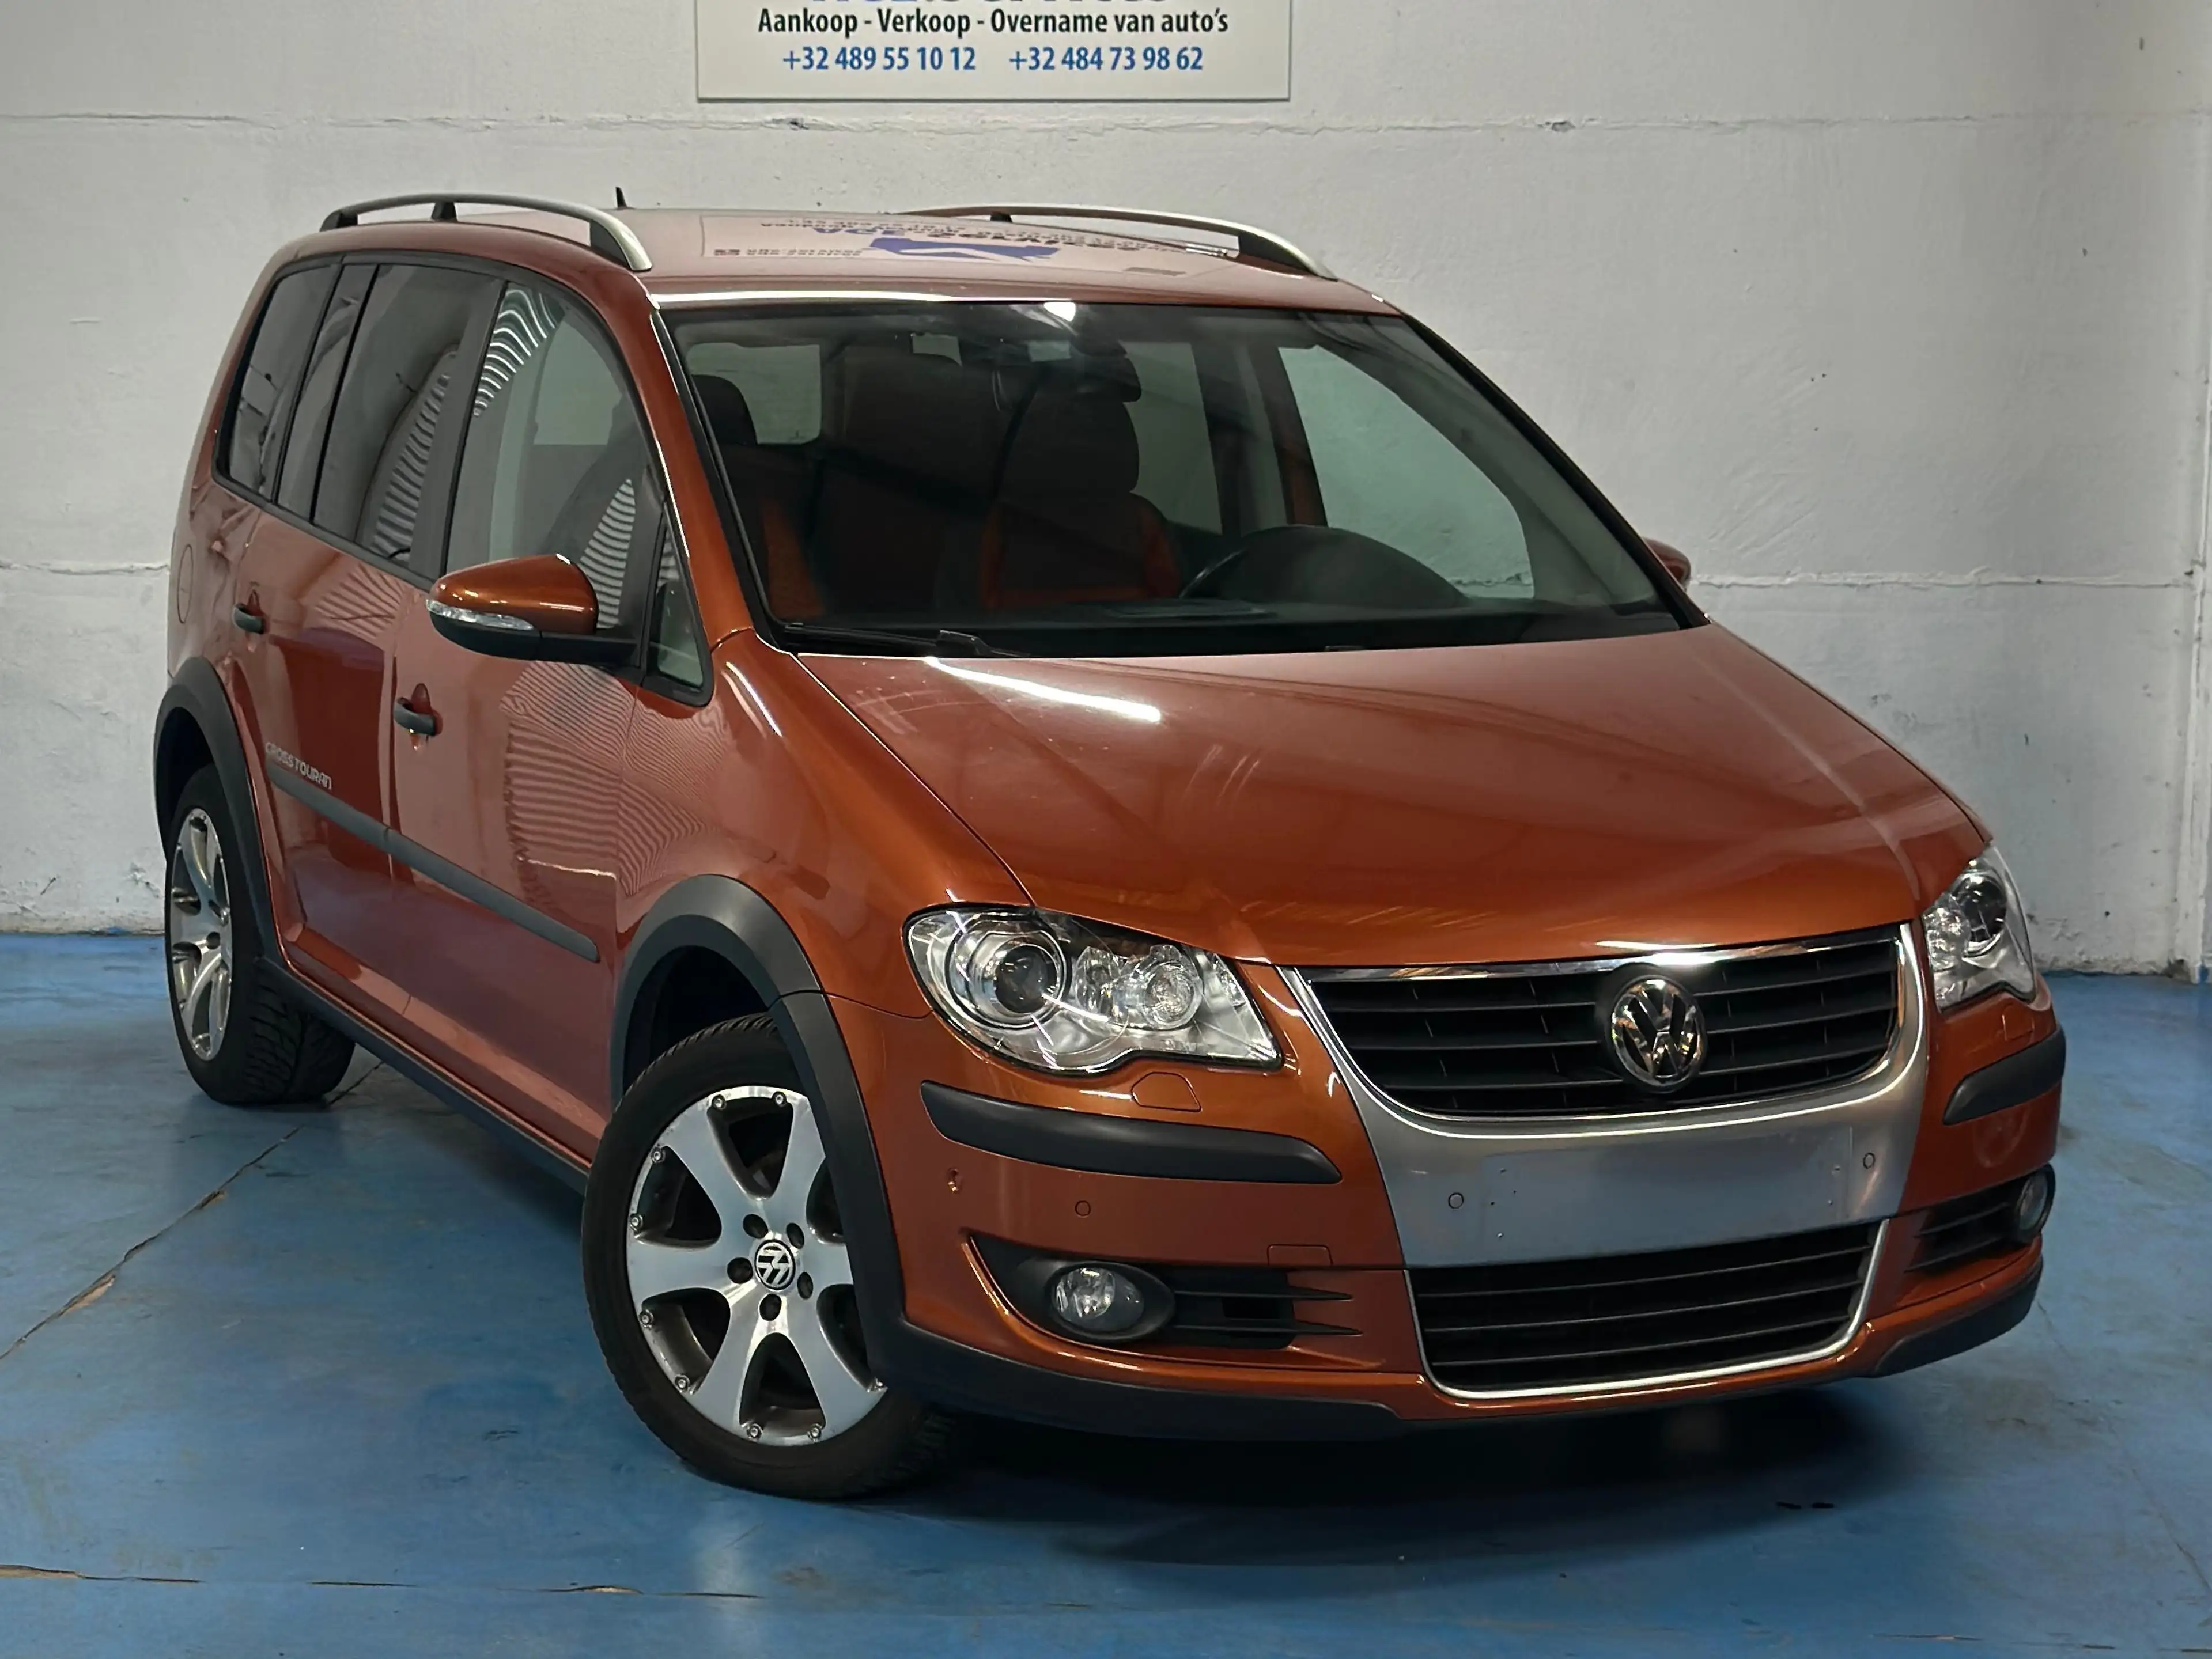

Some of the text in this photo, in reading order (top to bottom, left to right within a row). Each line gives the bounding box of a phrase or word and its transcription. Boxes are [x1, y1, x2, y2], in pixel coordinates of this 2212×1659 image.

[758, 7, 857, 39] Aankoop
[877, 8, 970, 39] Verkoop
[990, 8, 1107, 33] Overname
[1114, 14, 1154, 33] van
[783, 46, 976, 70] +32 489 55 10 12
[1009, 46, 1203, 70] +32 484 73 98 62
